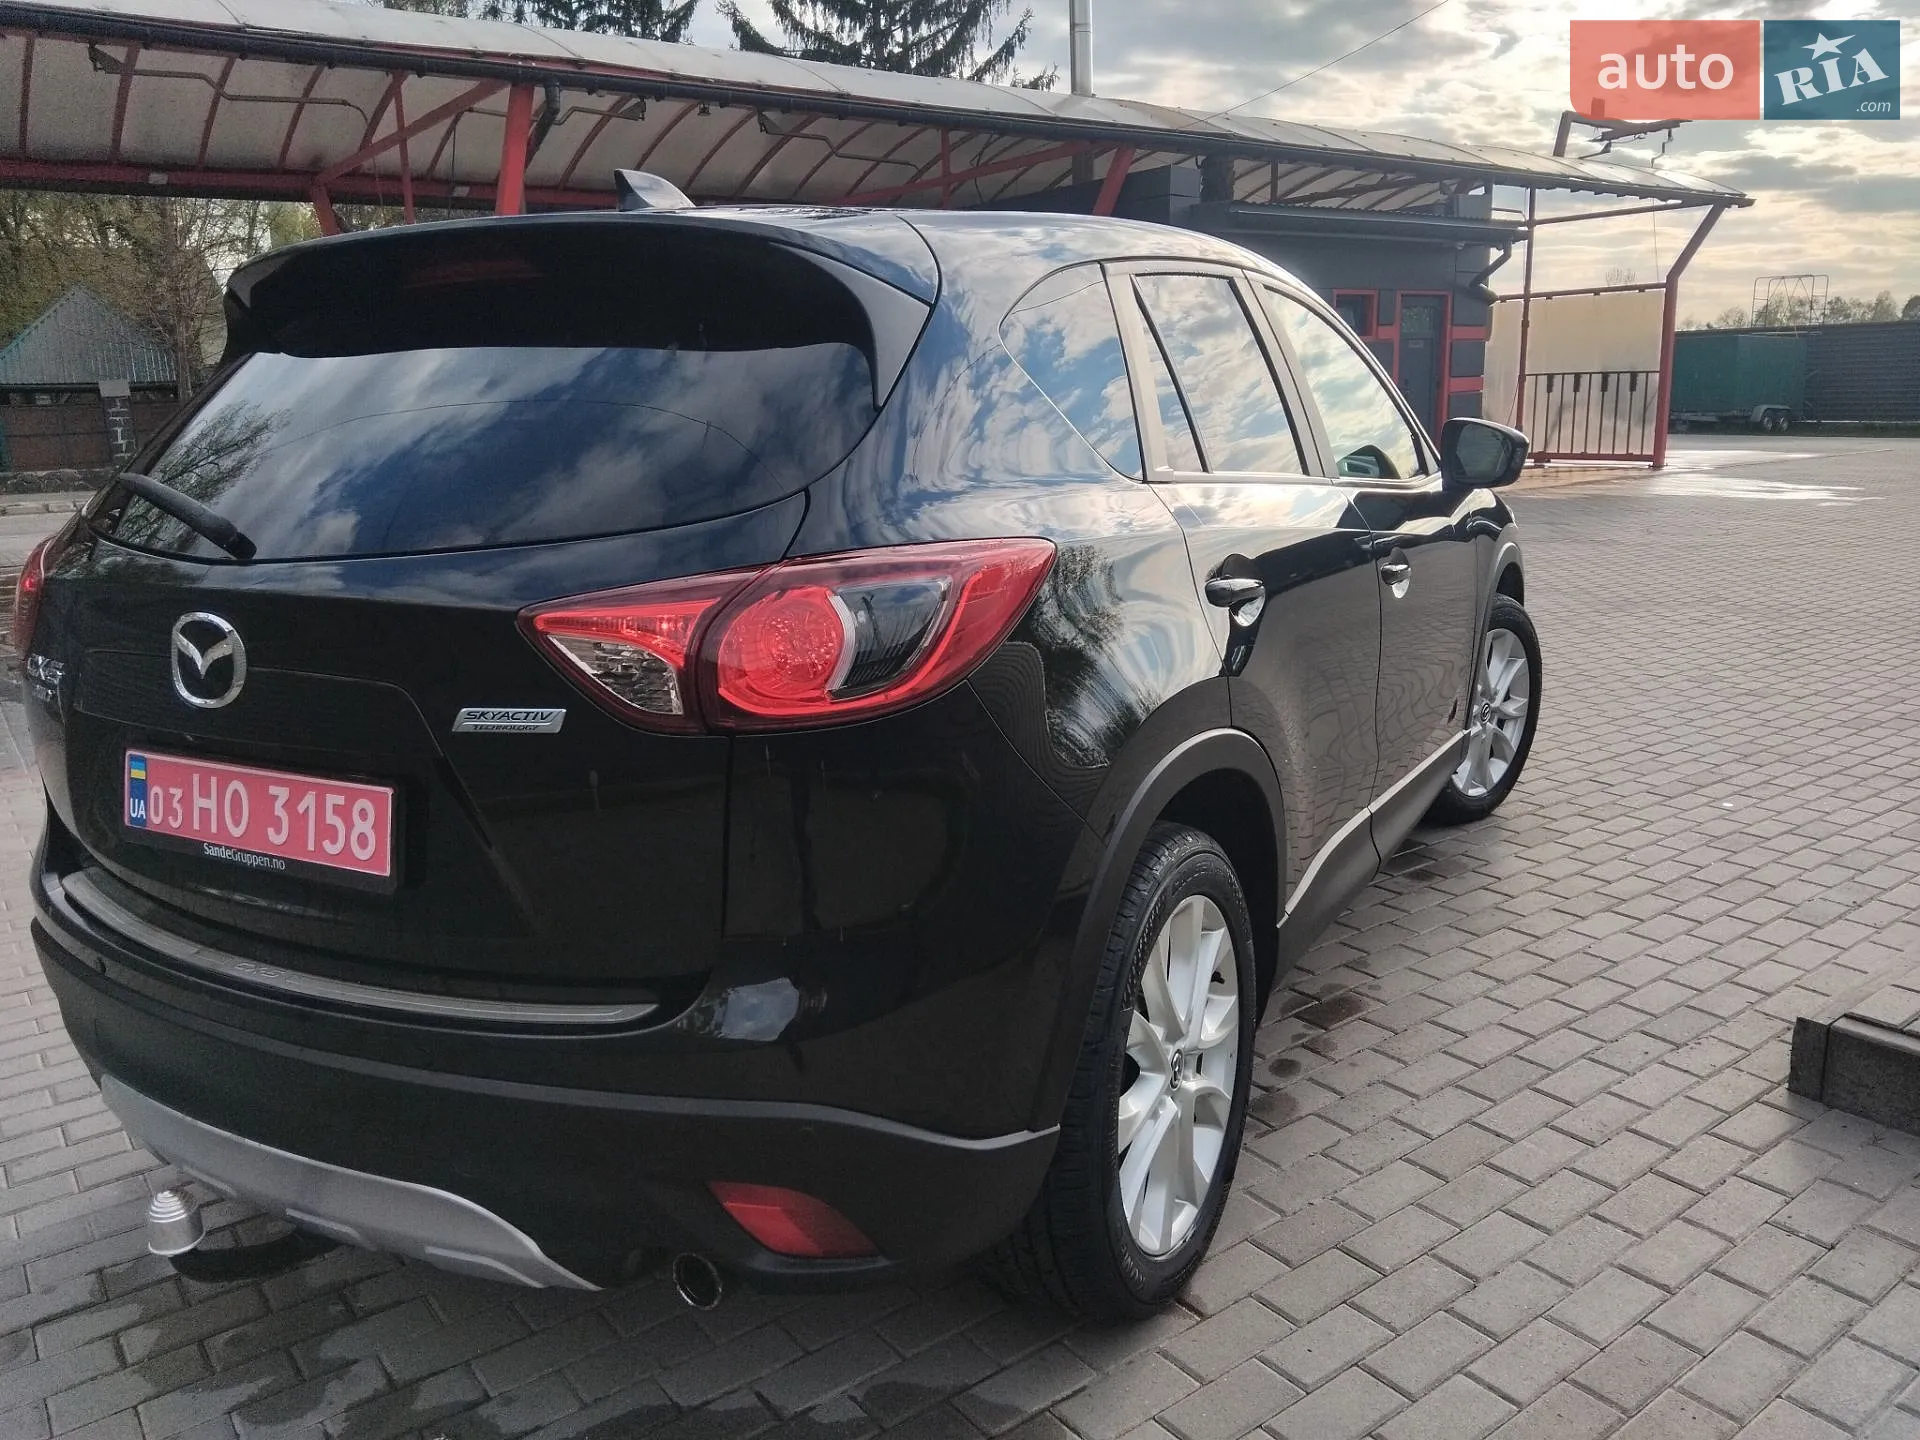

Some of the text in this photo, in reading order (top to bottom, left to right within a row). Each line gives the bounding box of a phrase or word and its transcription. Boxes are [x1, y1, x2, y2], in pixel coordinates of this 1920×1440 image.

[463, 711, 554, 721] SKYACTIV
[473, 724, 539, 732] TECHNOLOGY
[129, 798, 146, 819] UA
[150, 773, 376, 861] 03 HO 3158
[203, 842, 286, 873] SandeGruppen.no
